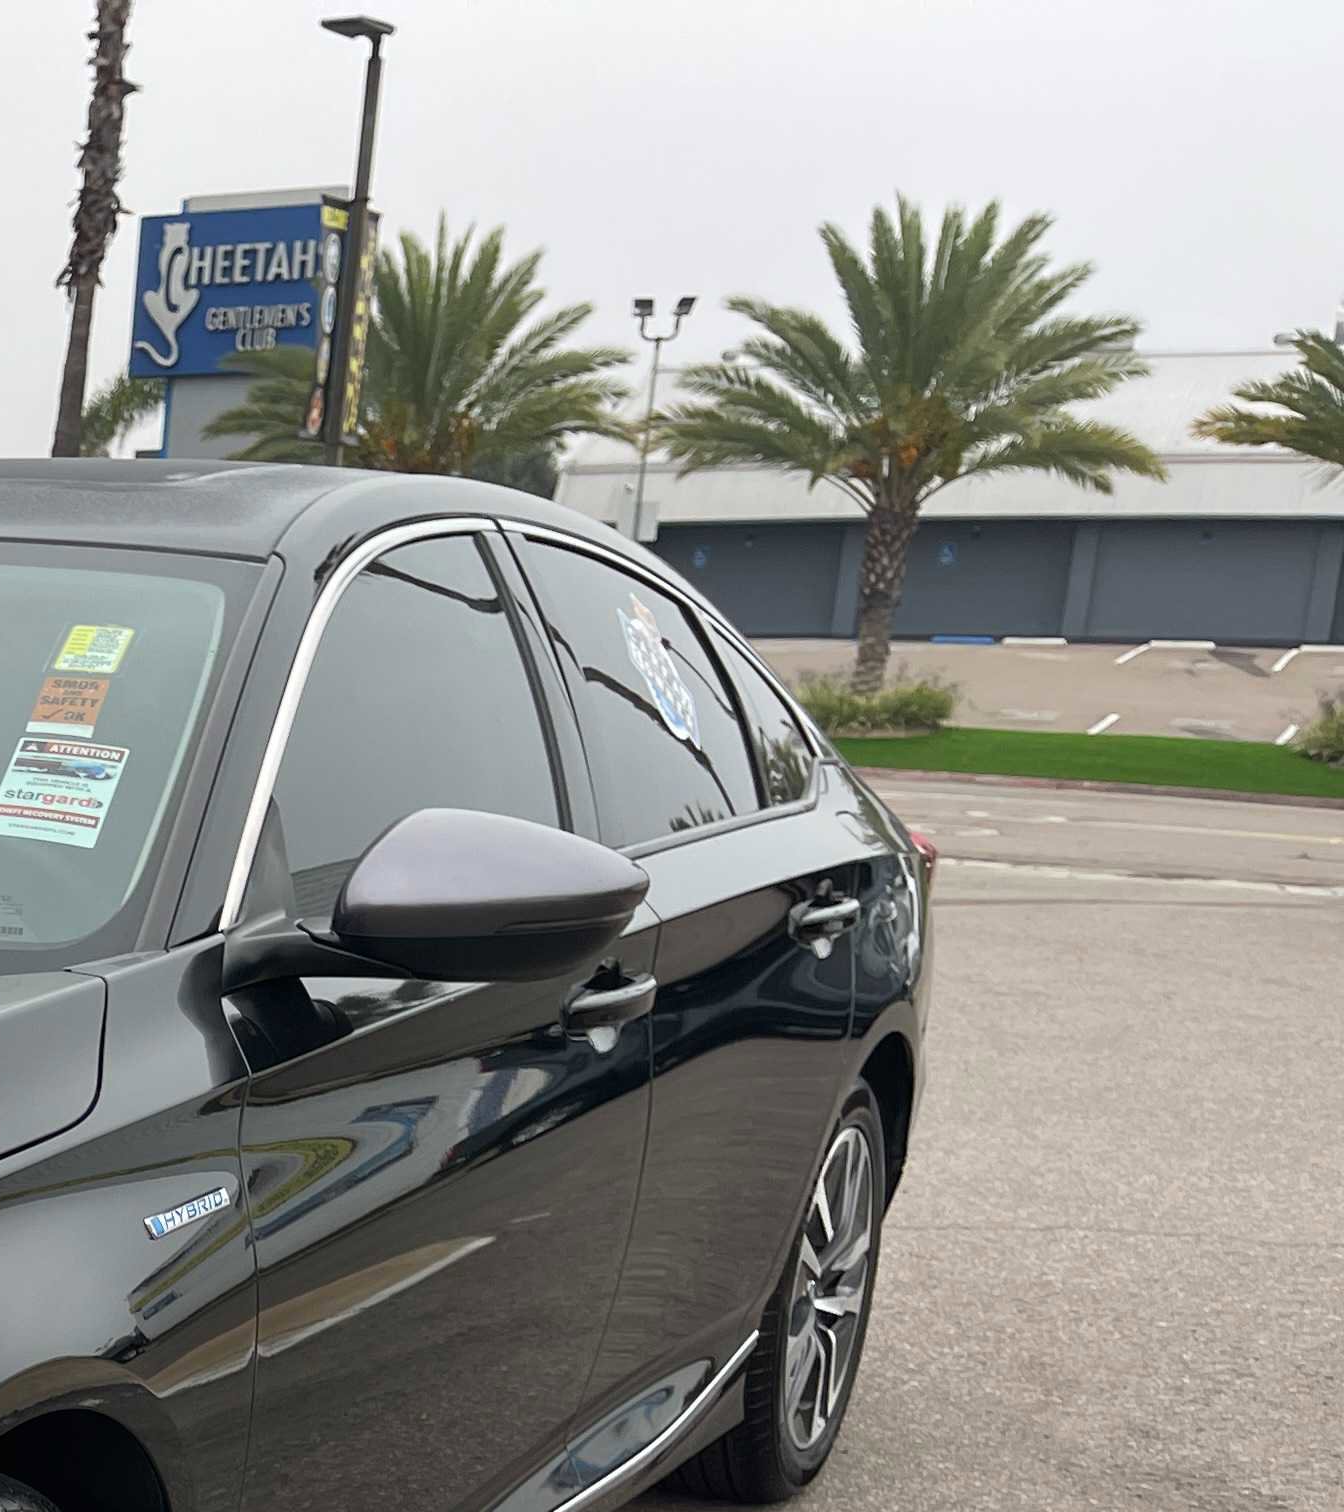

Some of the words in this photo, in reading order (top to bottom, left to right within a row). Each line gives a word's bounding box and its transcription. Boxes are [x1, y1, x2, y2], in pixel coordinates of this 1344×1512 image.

[170, 240, 321, 300] CHEETAH
[205, 302, 311, 331] GENTLEMEN'S
[236, 326, 278, 352] CLUB
[51, 679, 99, 690] SMOG
[40, 695, 100, 708] SAFETY
[64, 711, 86, 721] OK
[48, 743, 121, 761] ATTENTION
[4, 788, 98, 809] stargard
[23, 808, 64, 820] RECOVERY
[64, 815, 96, 825] SYSTEM
[163, 1191, 223, 1230] HYBRID
